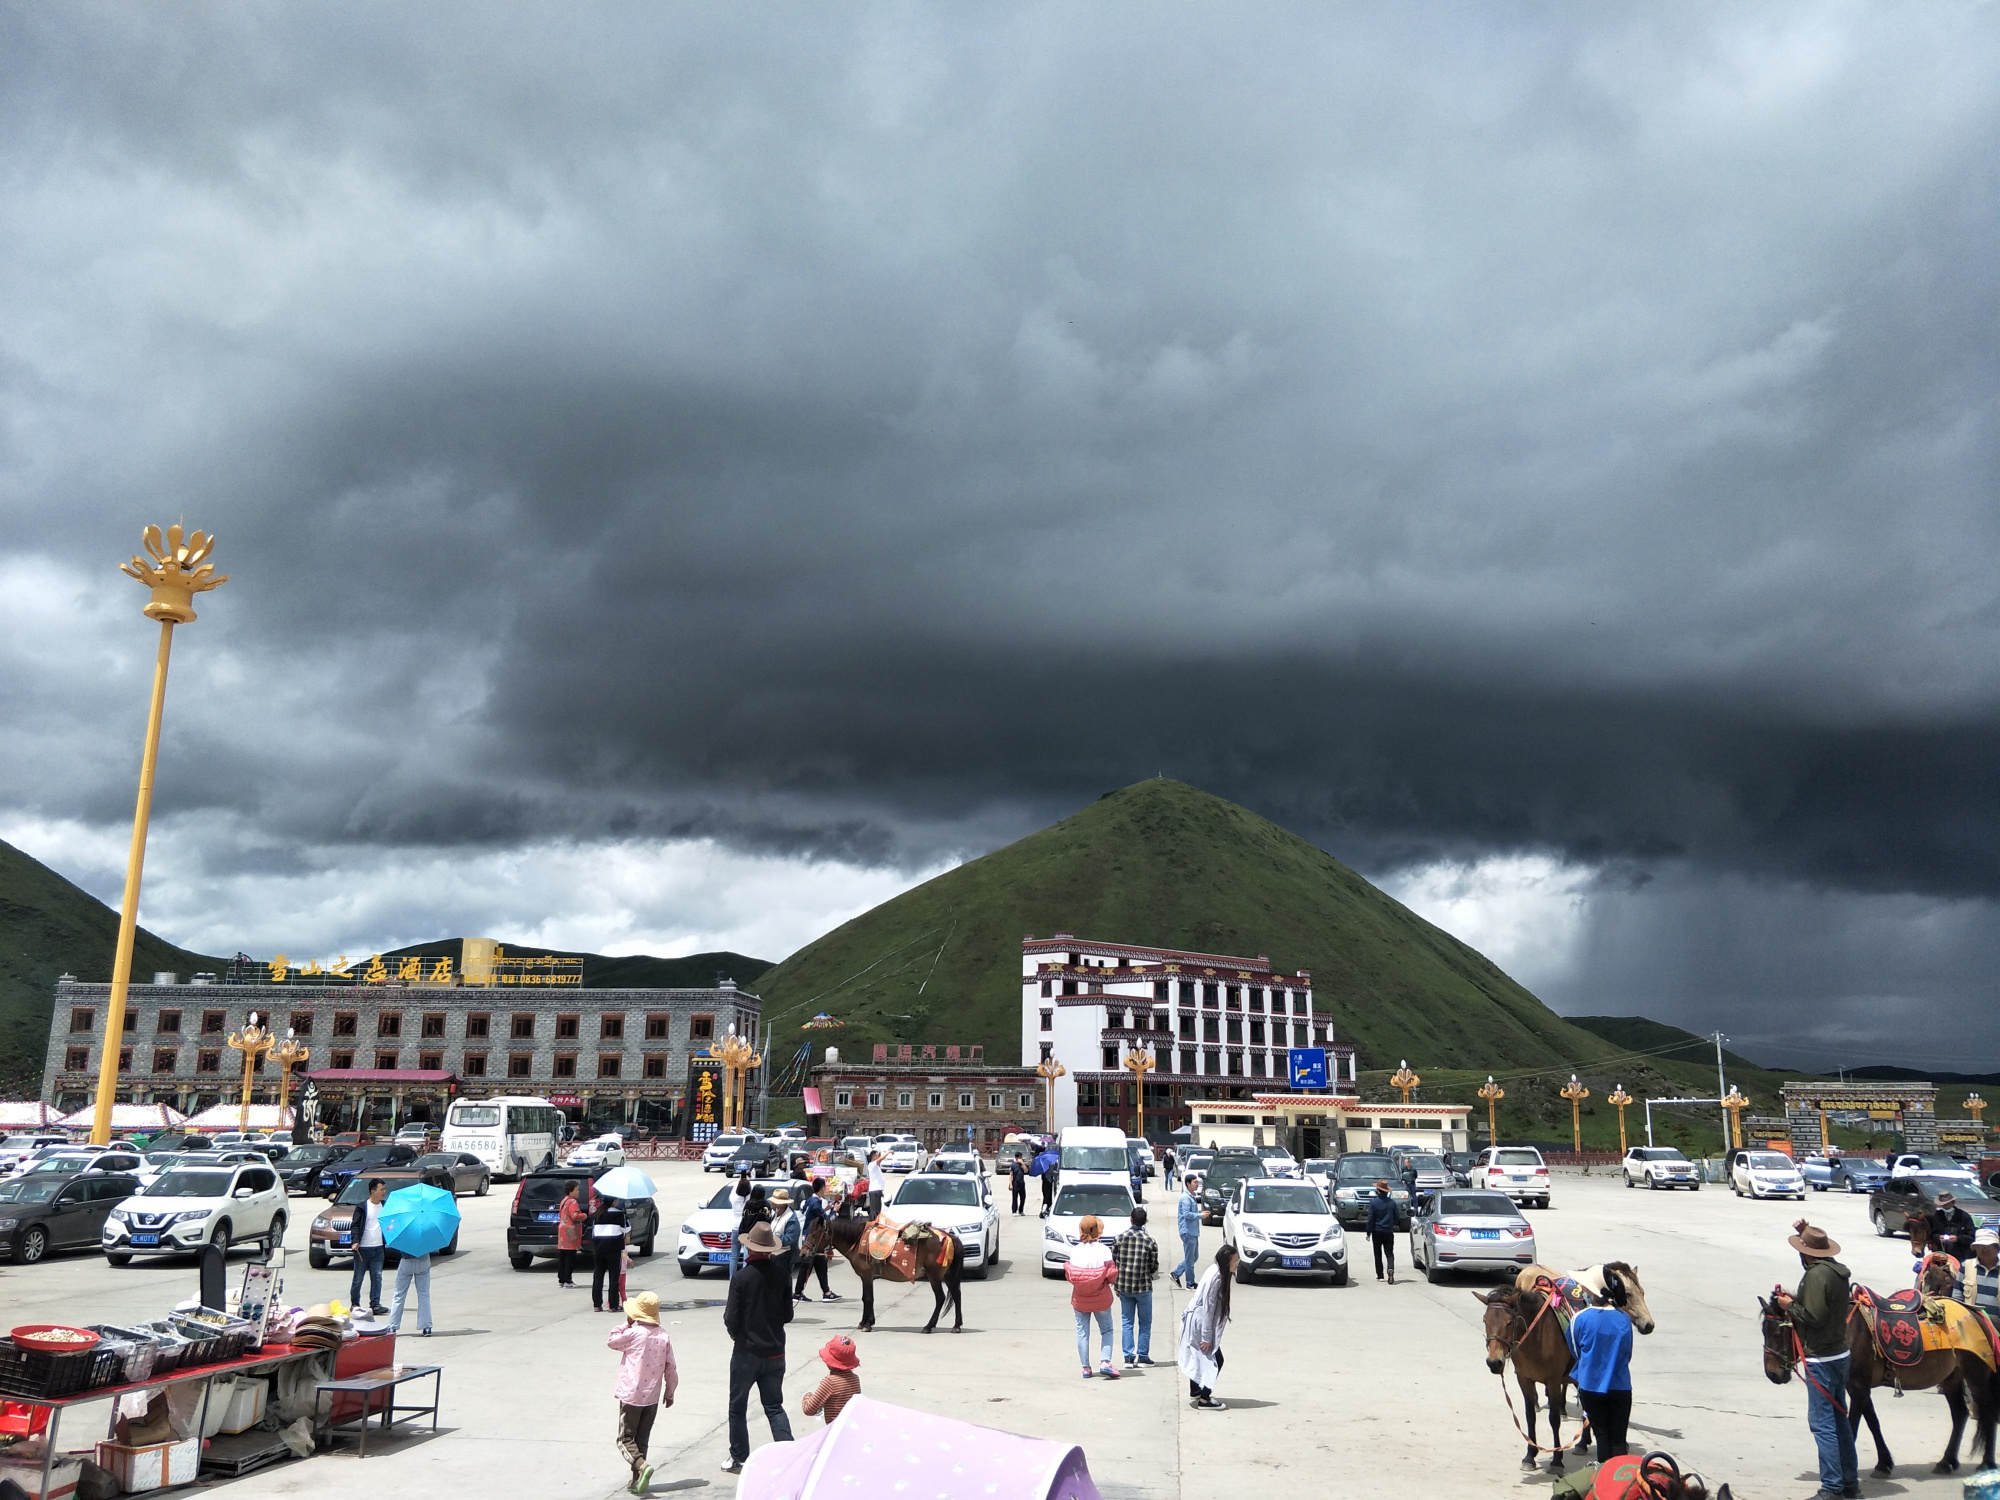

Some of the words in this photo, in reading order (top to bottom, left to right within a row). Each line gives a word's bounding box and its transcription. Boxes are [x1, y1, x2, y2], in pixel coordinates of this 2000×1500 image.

[268, 953, 453, 982] 雪山之恋酒店
